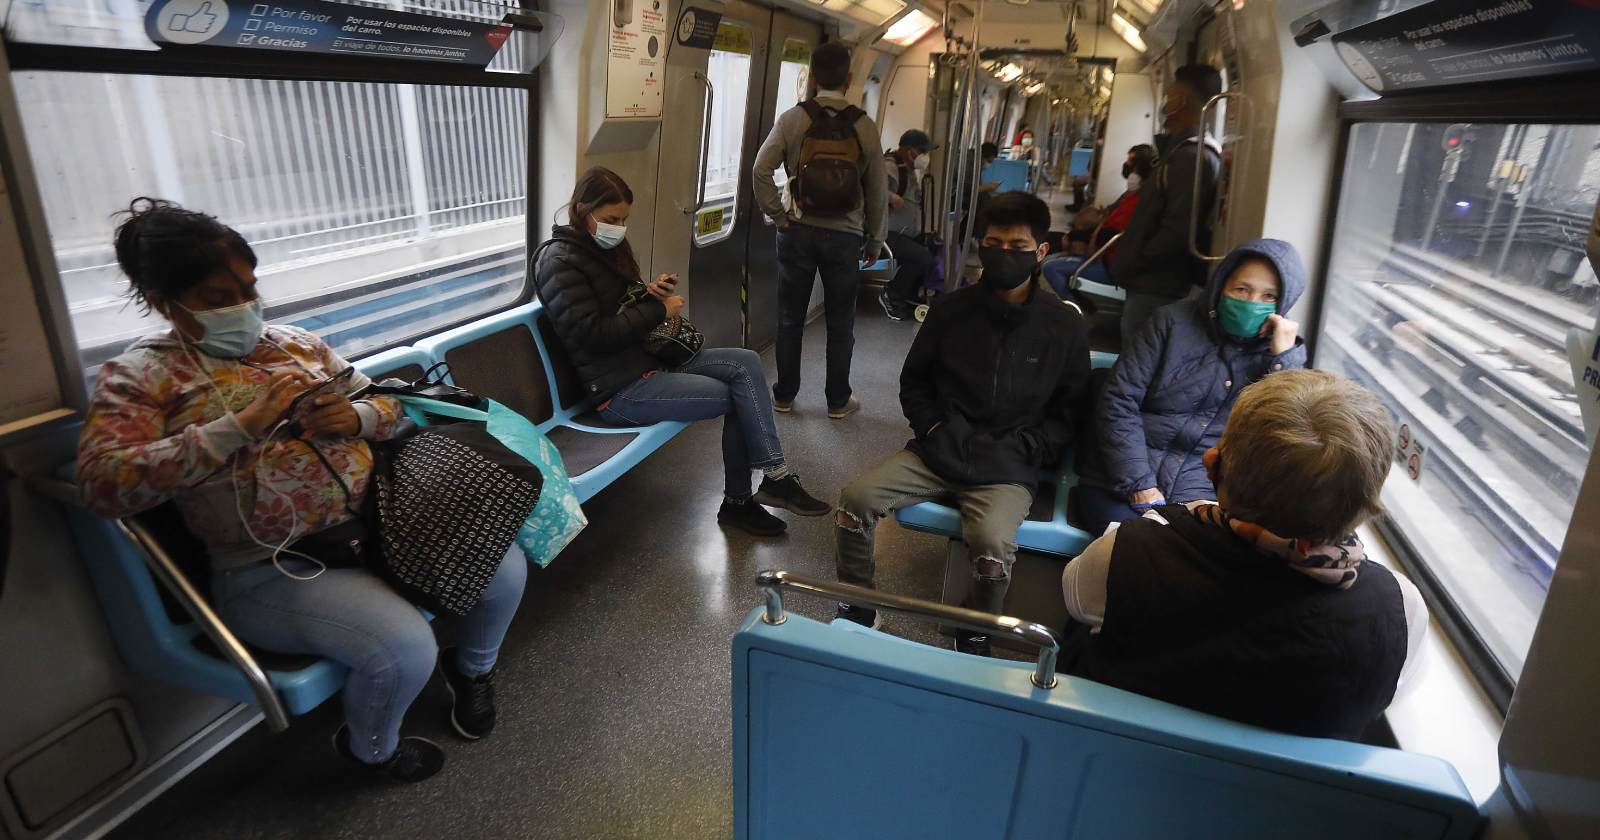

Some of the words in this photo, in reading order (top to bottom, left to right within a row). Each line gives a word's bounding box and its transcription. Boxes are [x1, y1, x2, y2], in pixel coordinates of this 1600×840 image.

[271, 7, 296, 18] Por
[298, 10, 332, 23] favor
[1476, 0, 1534, 22] disponibles
[264, 21, 318, 36] Permiso
[346, 16, 363, 25] Por
[364, 19, 382, 27] usar
[383, 21, 397, 29] los
[398, 23, 432, 33] espacios
[432, 26, 472, 37] disponibles
[358, 27, 382, 35] carro.
[257, 36, 309, 48] Gracias
[344, 41, 364, 50] viaje
[412, 47, 444, 56] hacemos
[444, 49, 467, 58] juntos.
[1501, 49, 1547, 63] hacemos
[1545, 42, 1588, 61] juntos.
